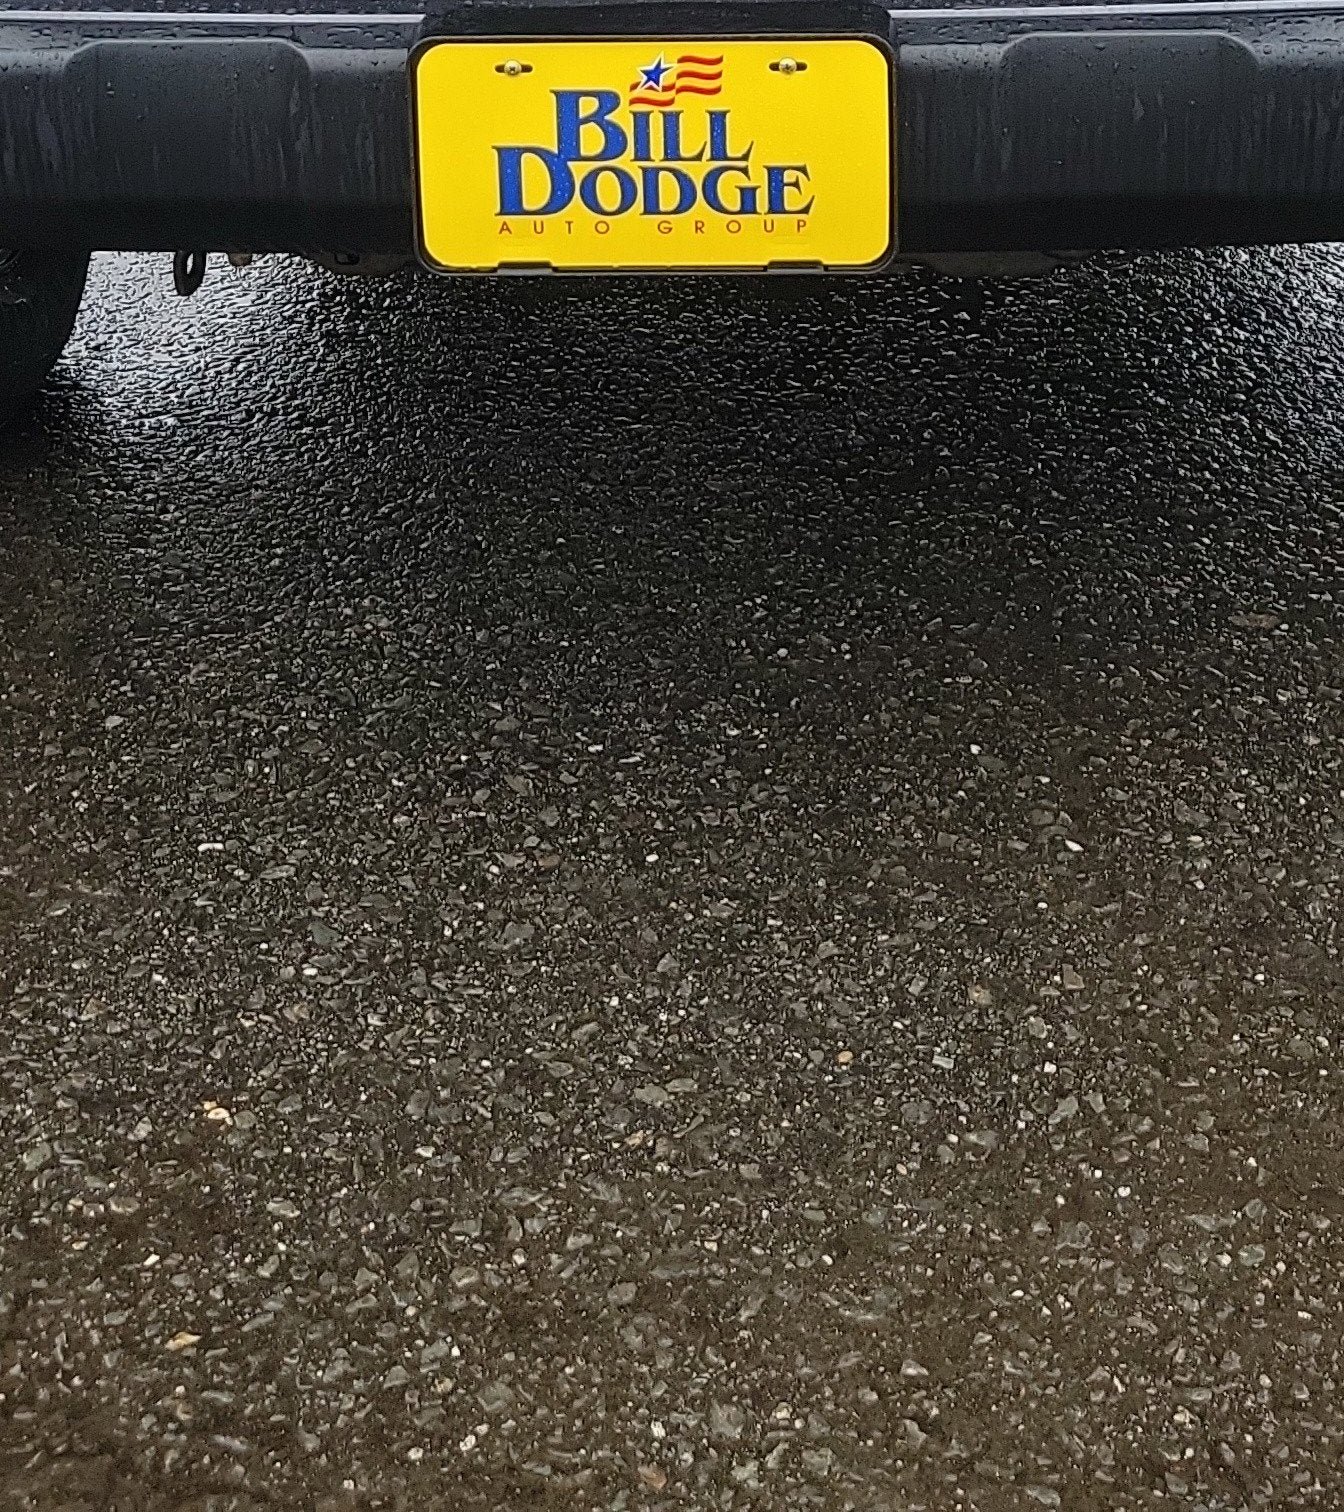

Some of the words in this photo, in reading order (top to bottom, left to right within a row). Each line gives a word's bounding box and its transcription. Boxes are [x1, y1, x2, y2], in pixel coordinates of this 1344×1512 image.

[550, 89, 754, 162] BILL
[491, 144, 815, 216] DODGE
[498, 220, 610, 235] AUTO
[657, 218, 809, 235] GROUP
